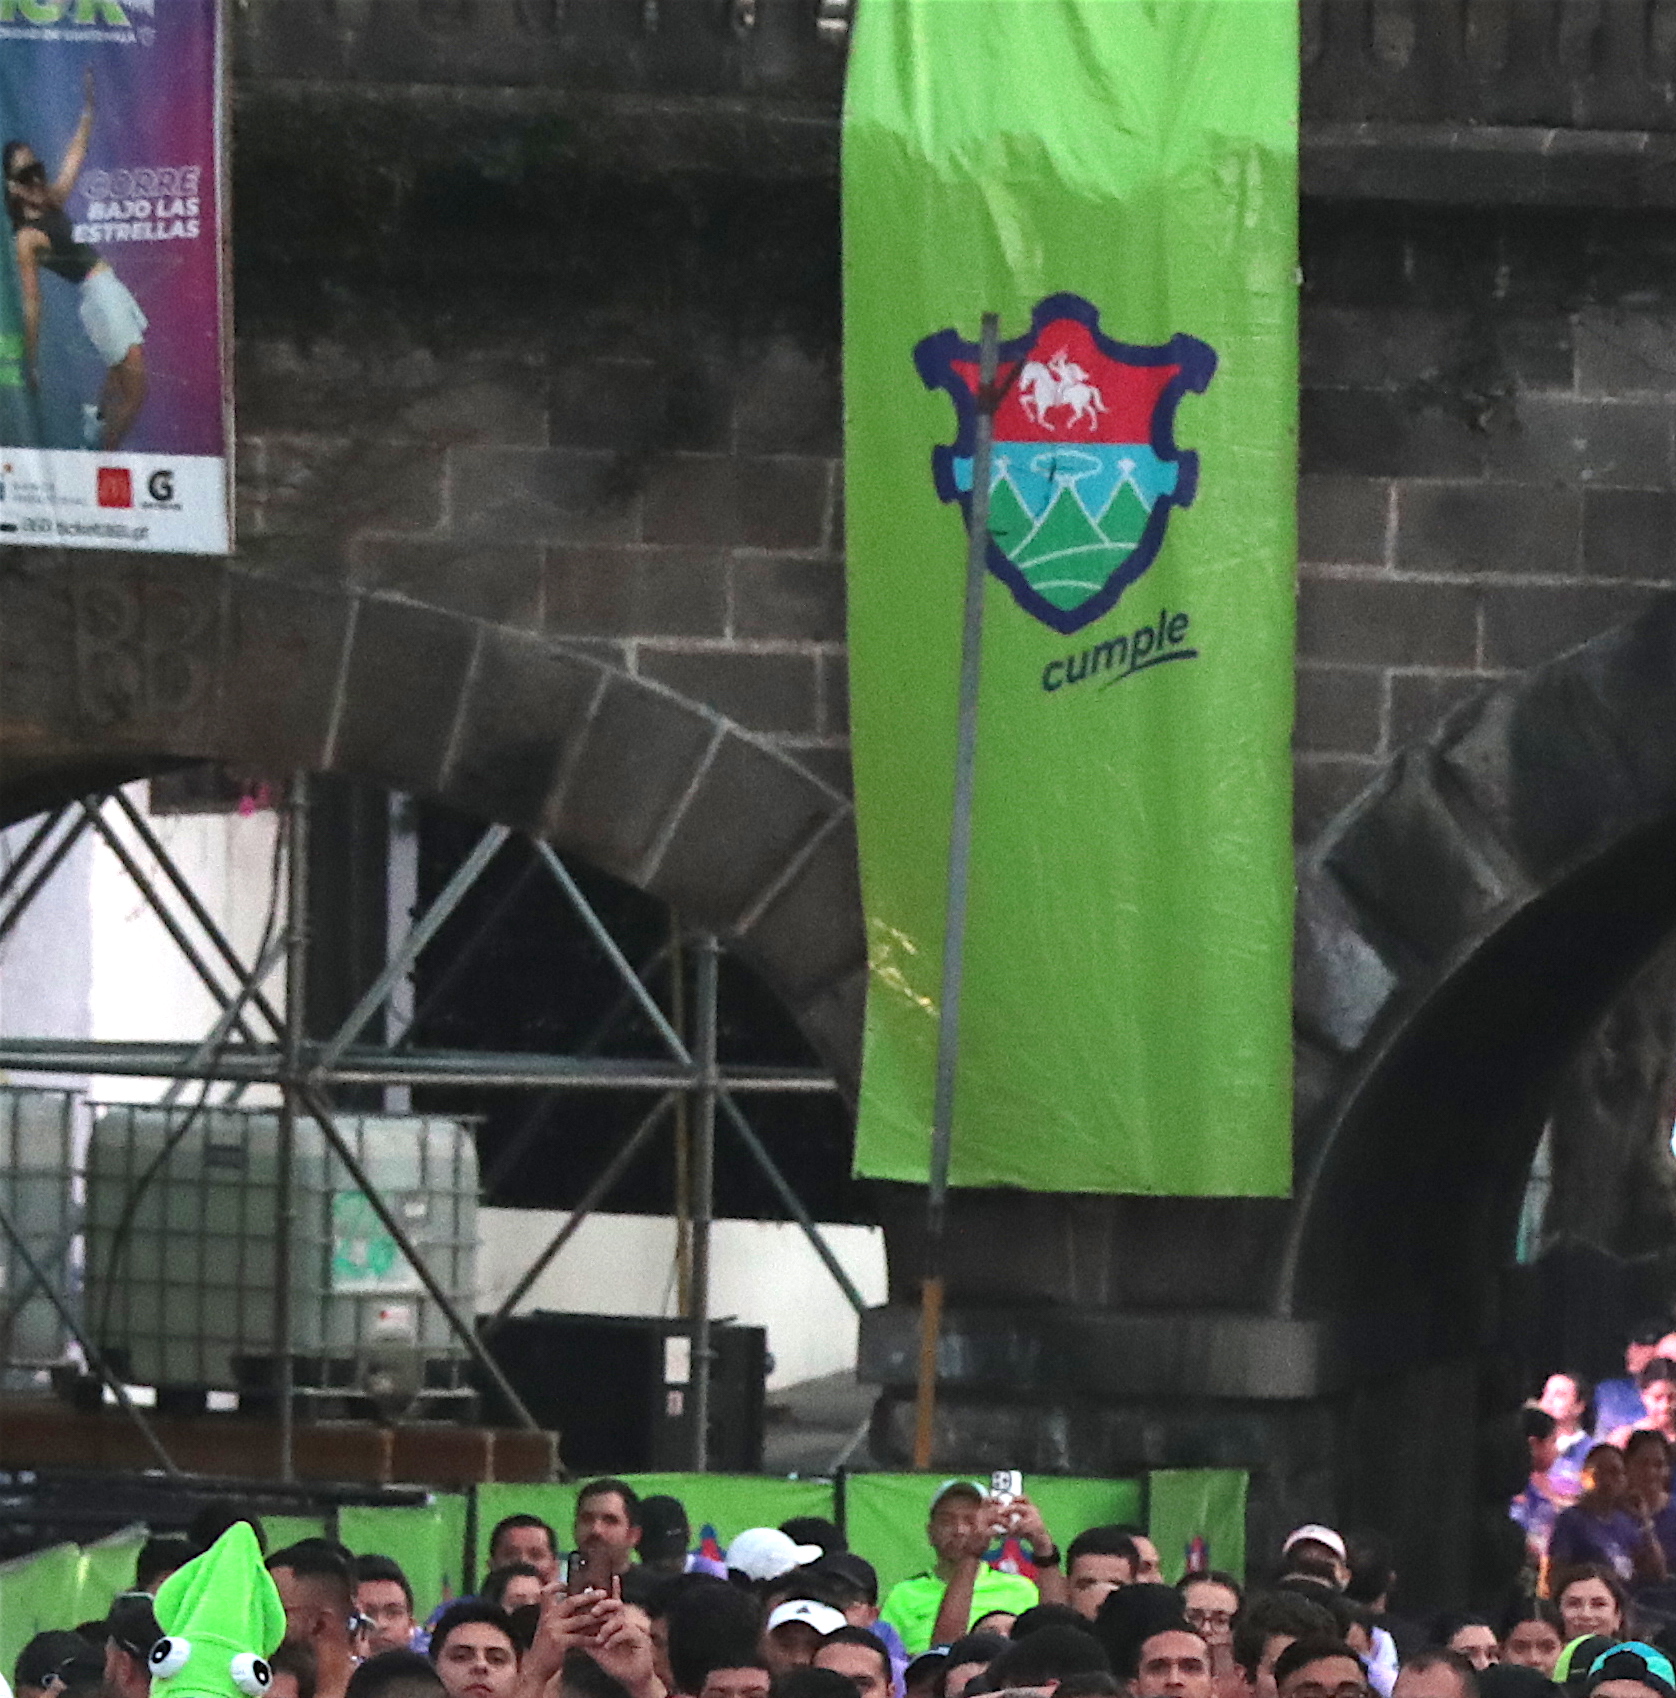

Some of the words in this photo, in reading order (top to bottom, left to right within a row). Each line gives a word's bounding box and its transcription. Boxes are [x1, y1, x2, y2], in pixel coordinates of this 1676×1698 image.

[87, 200, 152, 221] BAJO
[156, 197, 200, 218] LAS
[71, 219, 200, 243] ESTRELLAS
[1041, 608, 1197, 692] cumple
